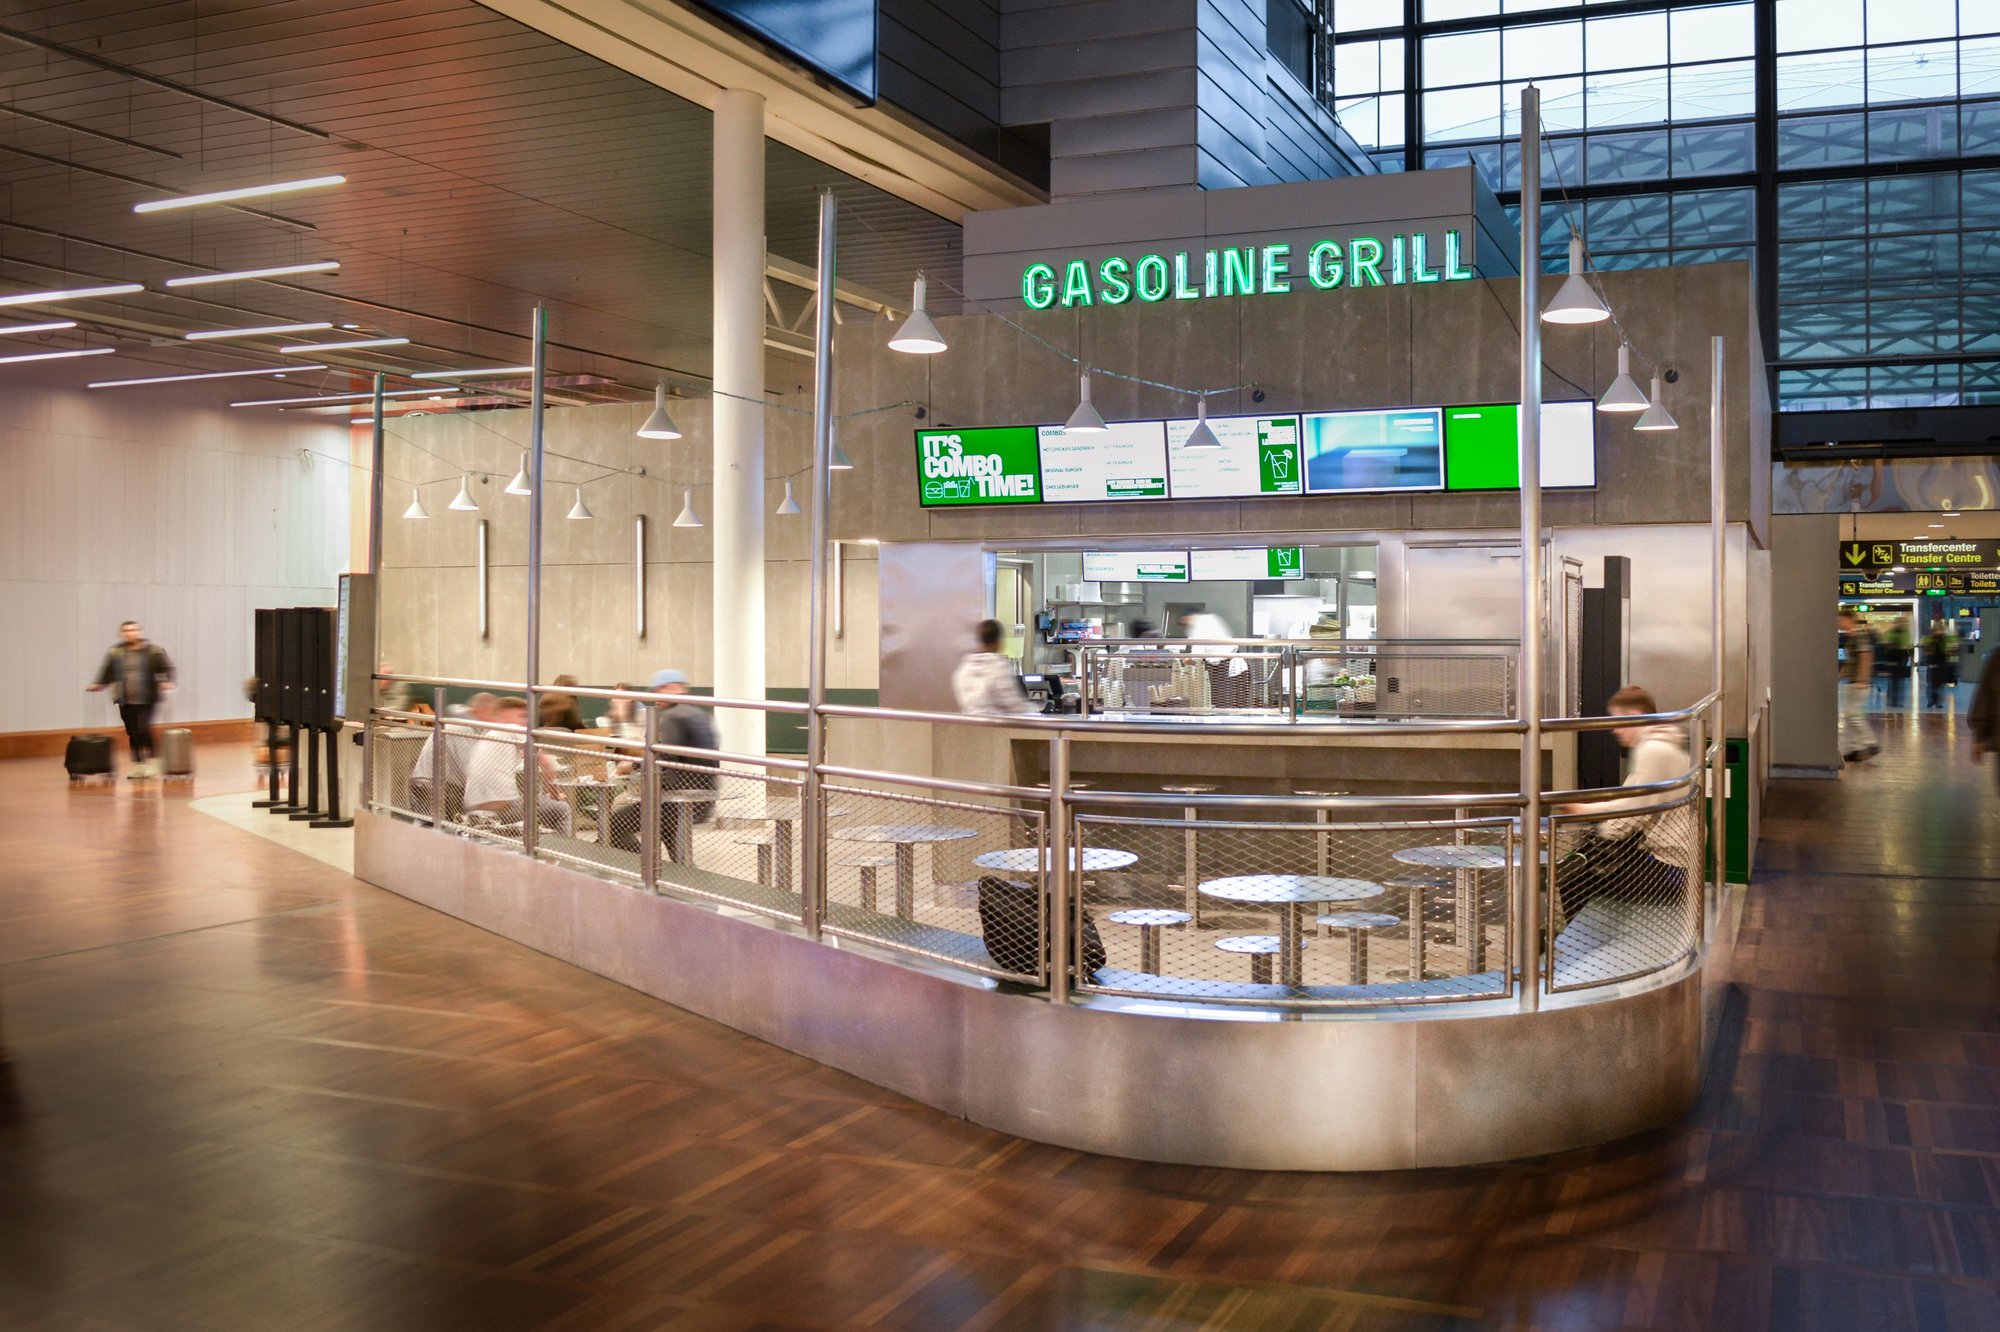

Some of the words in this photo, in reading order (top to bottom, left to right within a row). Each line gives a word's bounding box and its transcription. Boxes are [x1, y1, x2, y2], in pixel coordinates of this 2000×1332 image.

[1023, 243, 1290, 309] GASOLINE
[1308, 230, 1472, 289] GRILL
[923, 435, 963, 457] IT'S
[924, 454, 1003, 478] COMBO
[975, 475, 1034, 497] TIME!
[1900, 543, 1976, 552] Transfercenter
[1900, 553, 1943, 563] Transfer
[1946, 553, 1981, 563] Centre
[1971, 580, 1996, 588] Toilets
